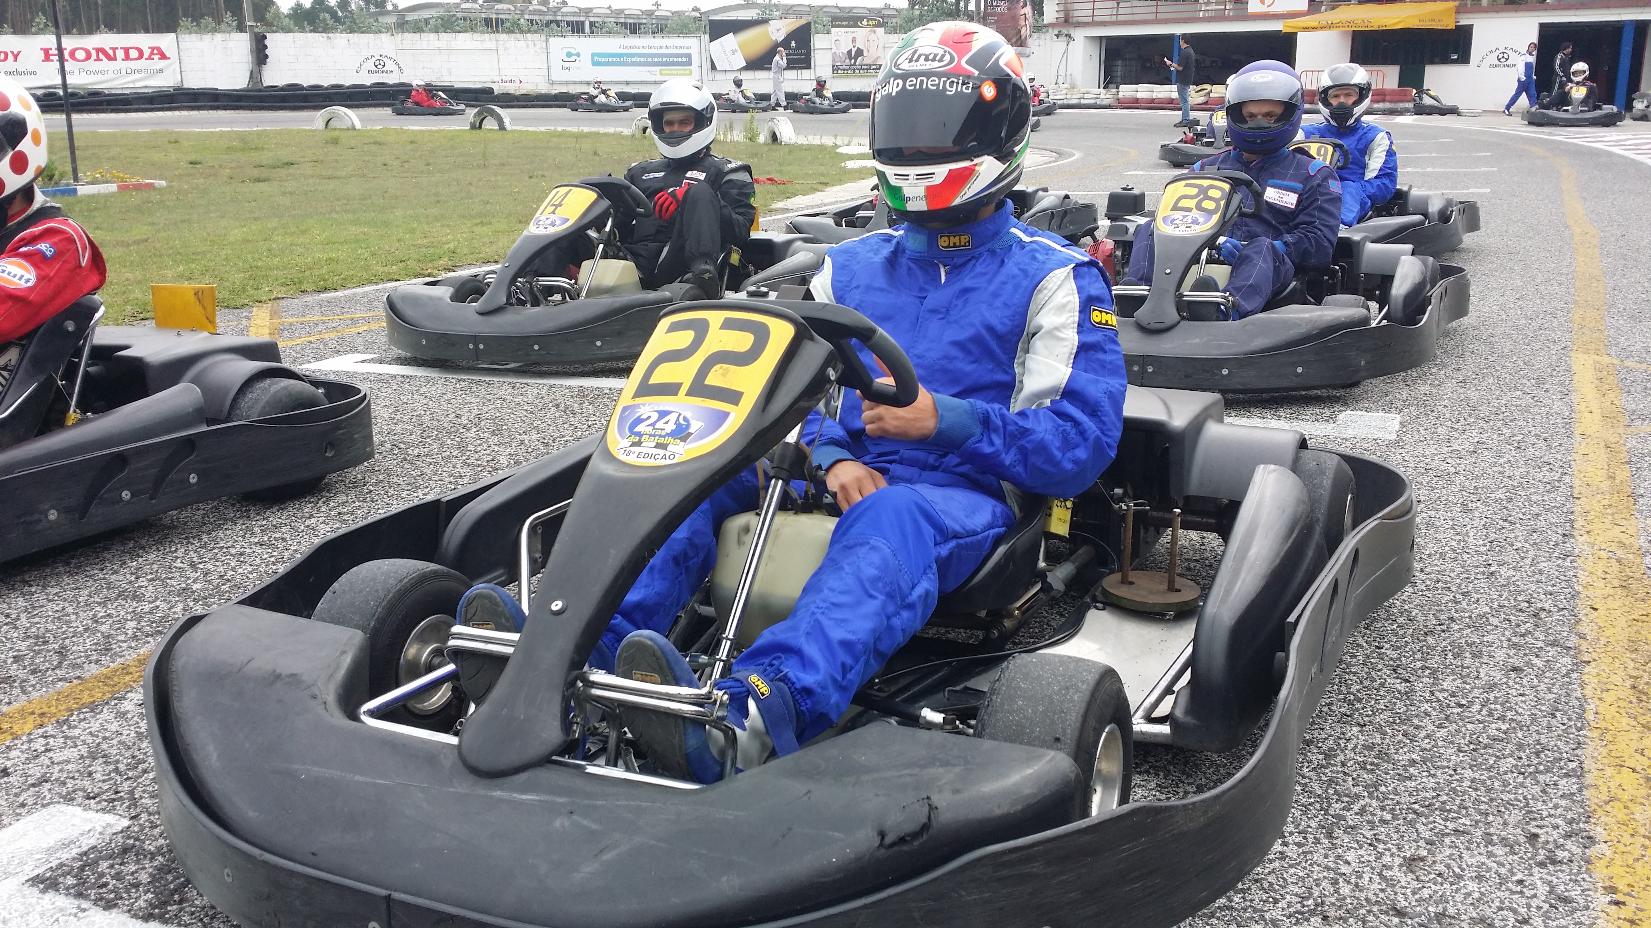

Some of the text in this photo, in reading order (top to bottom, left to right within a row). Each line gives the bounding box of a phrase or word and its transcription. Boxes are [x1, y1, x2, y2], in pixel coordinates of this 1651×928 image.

[40, 46, 171, 62] HONDA
[896, 49, 947, 66] Arai
[4, 68, 38, 76] exclusivo
[78, 68, 110, 76] Power
[113, 67, 123, 75] of
[126, 67, 164, 75] Dreams
[906, 76, 973, 94] energia
[540, 188, 574, 215] 14
[1170, 183, 1229, 215] 28
[632, 317, 771, 407] 22
[633, 411, 677, 433] 24
[641, 435, 681, 446] Batalha
[751, 675, 769, 694] OMP
